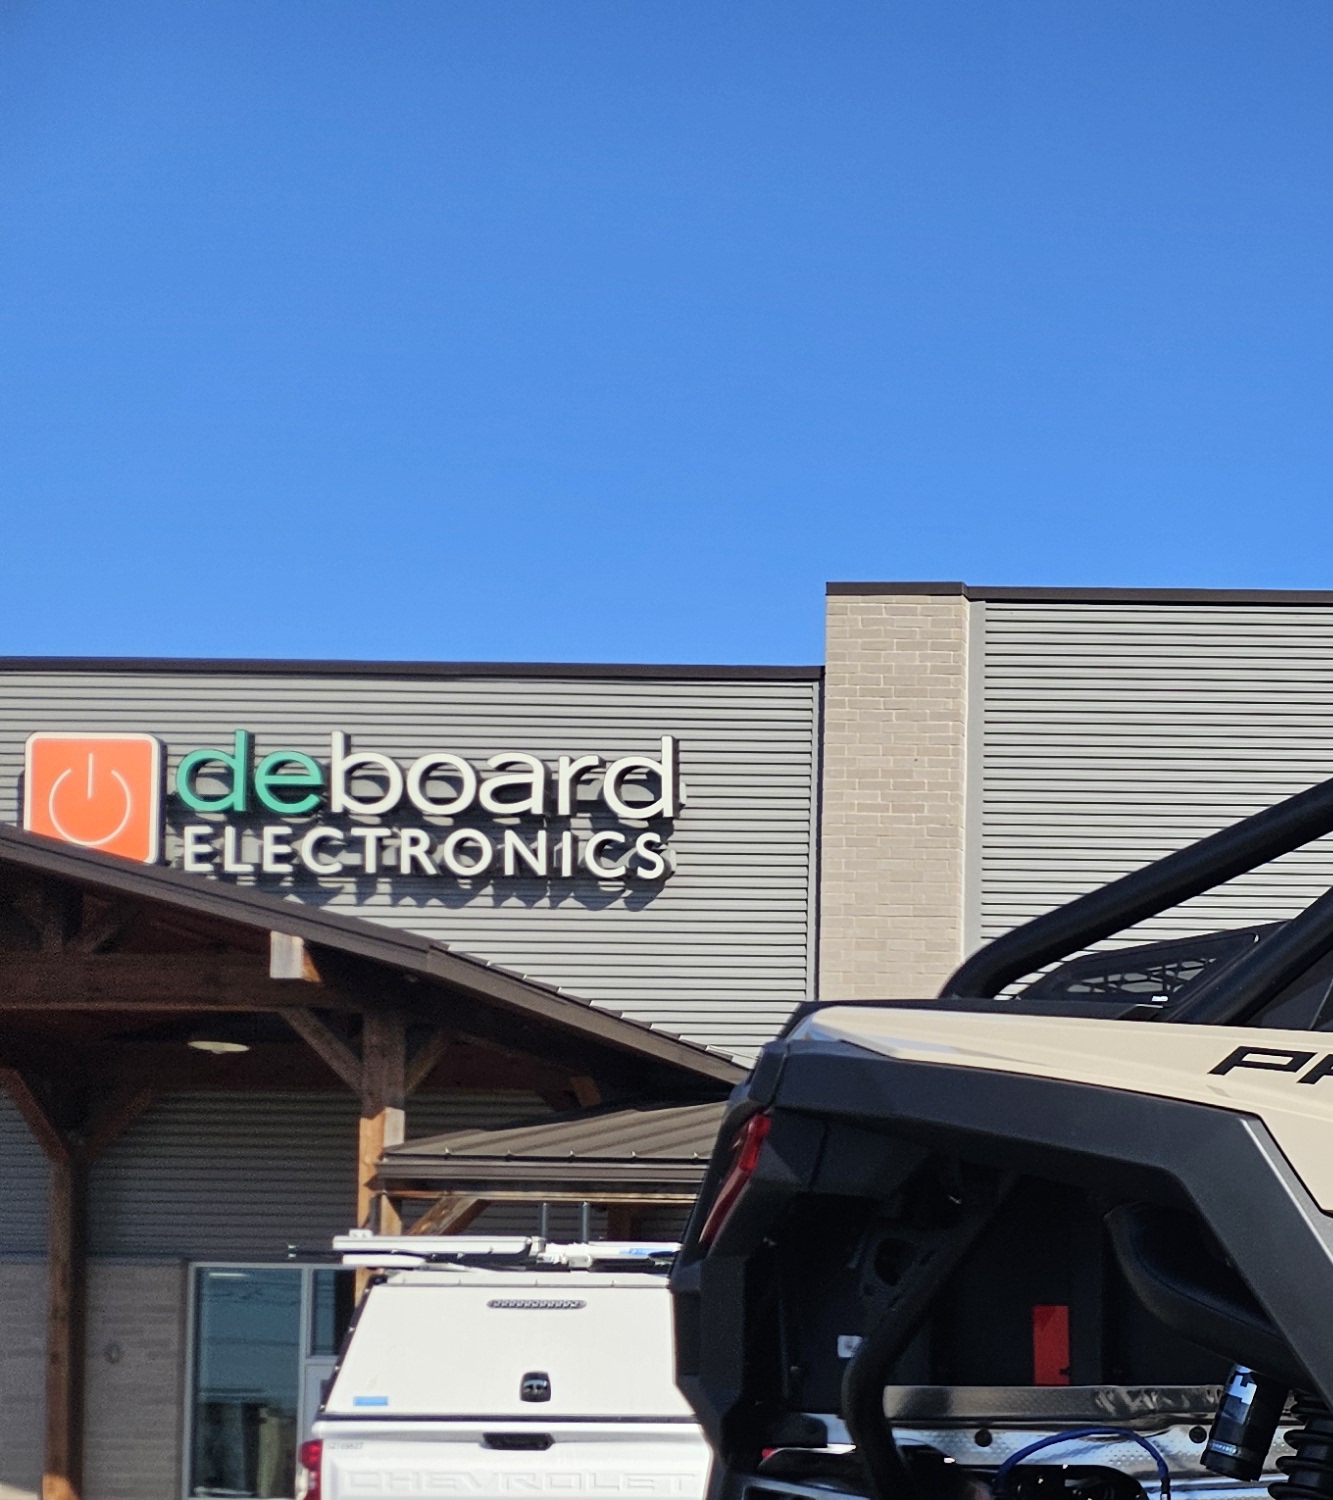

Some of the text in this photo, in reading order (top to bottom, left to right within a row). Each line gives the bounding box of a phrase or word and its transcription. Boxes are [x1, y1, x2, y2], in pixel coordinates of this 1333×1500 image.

[175, 729, 677, 819] deboard
[182, 825, 668, 880] ELECTRONICS
[345, 1470, 697, 1492] CHEVROLET
